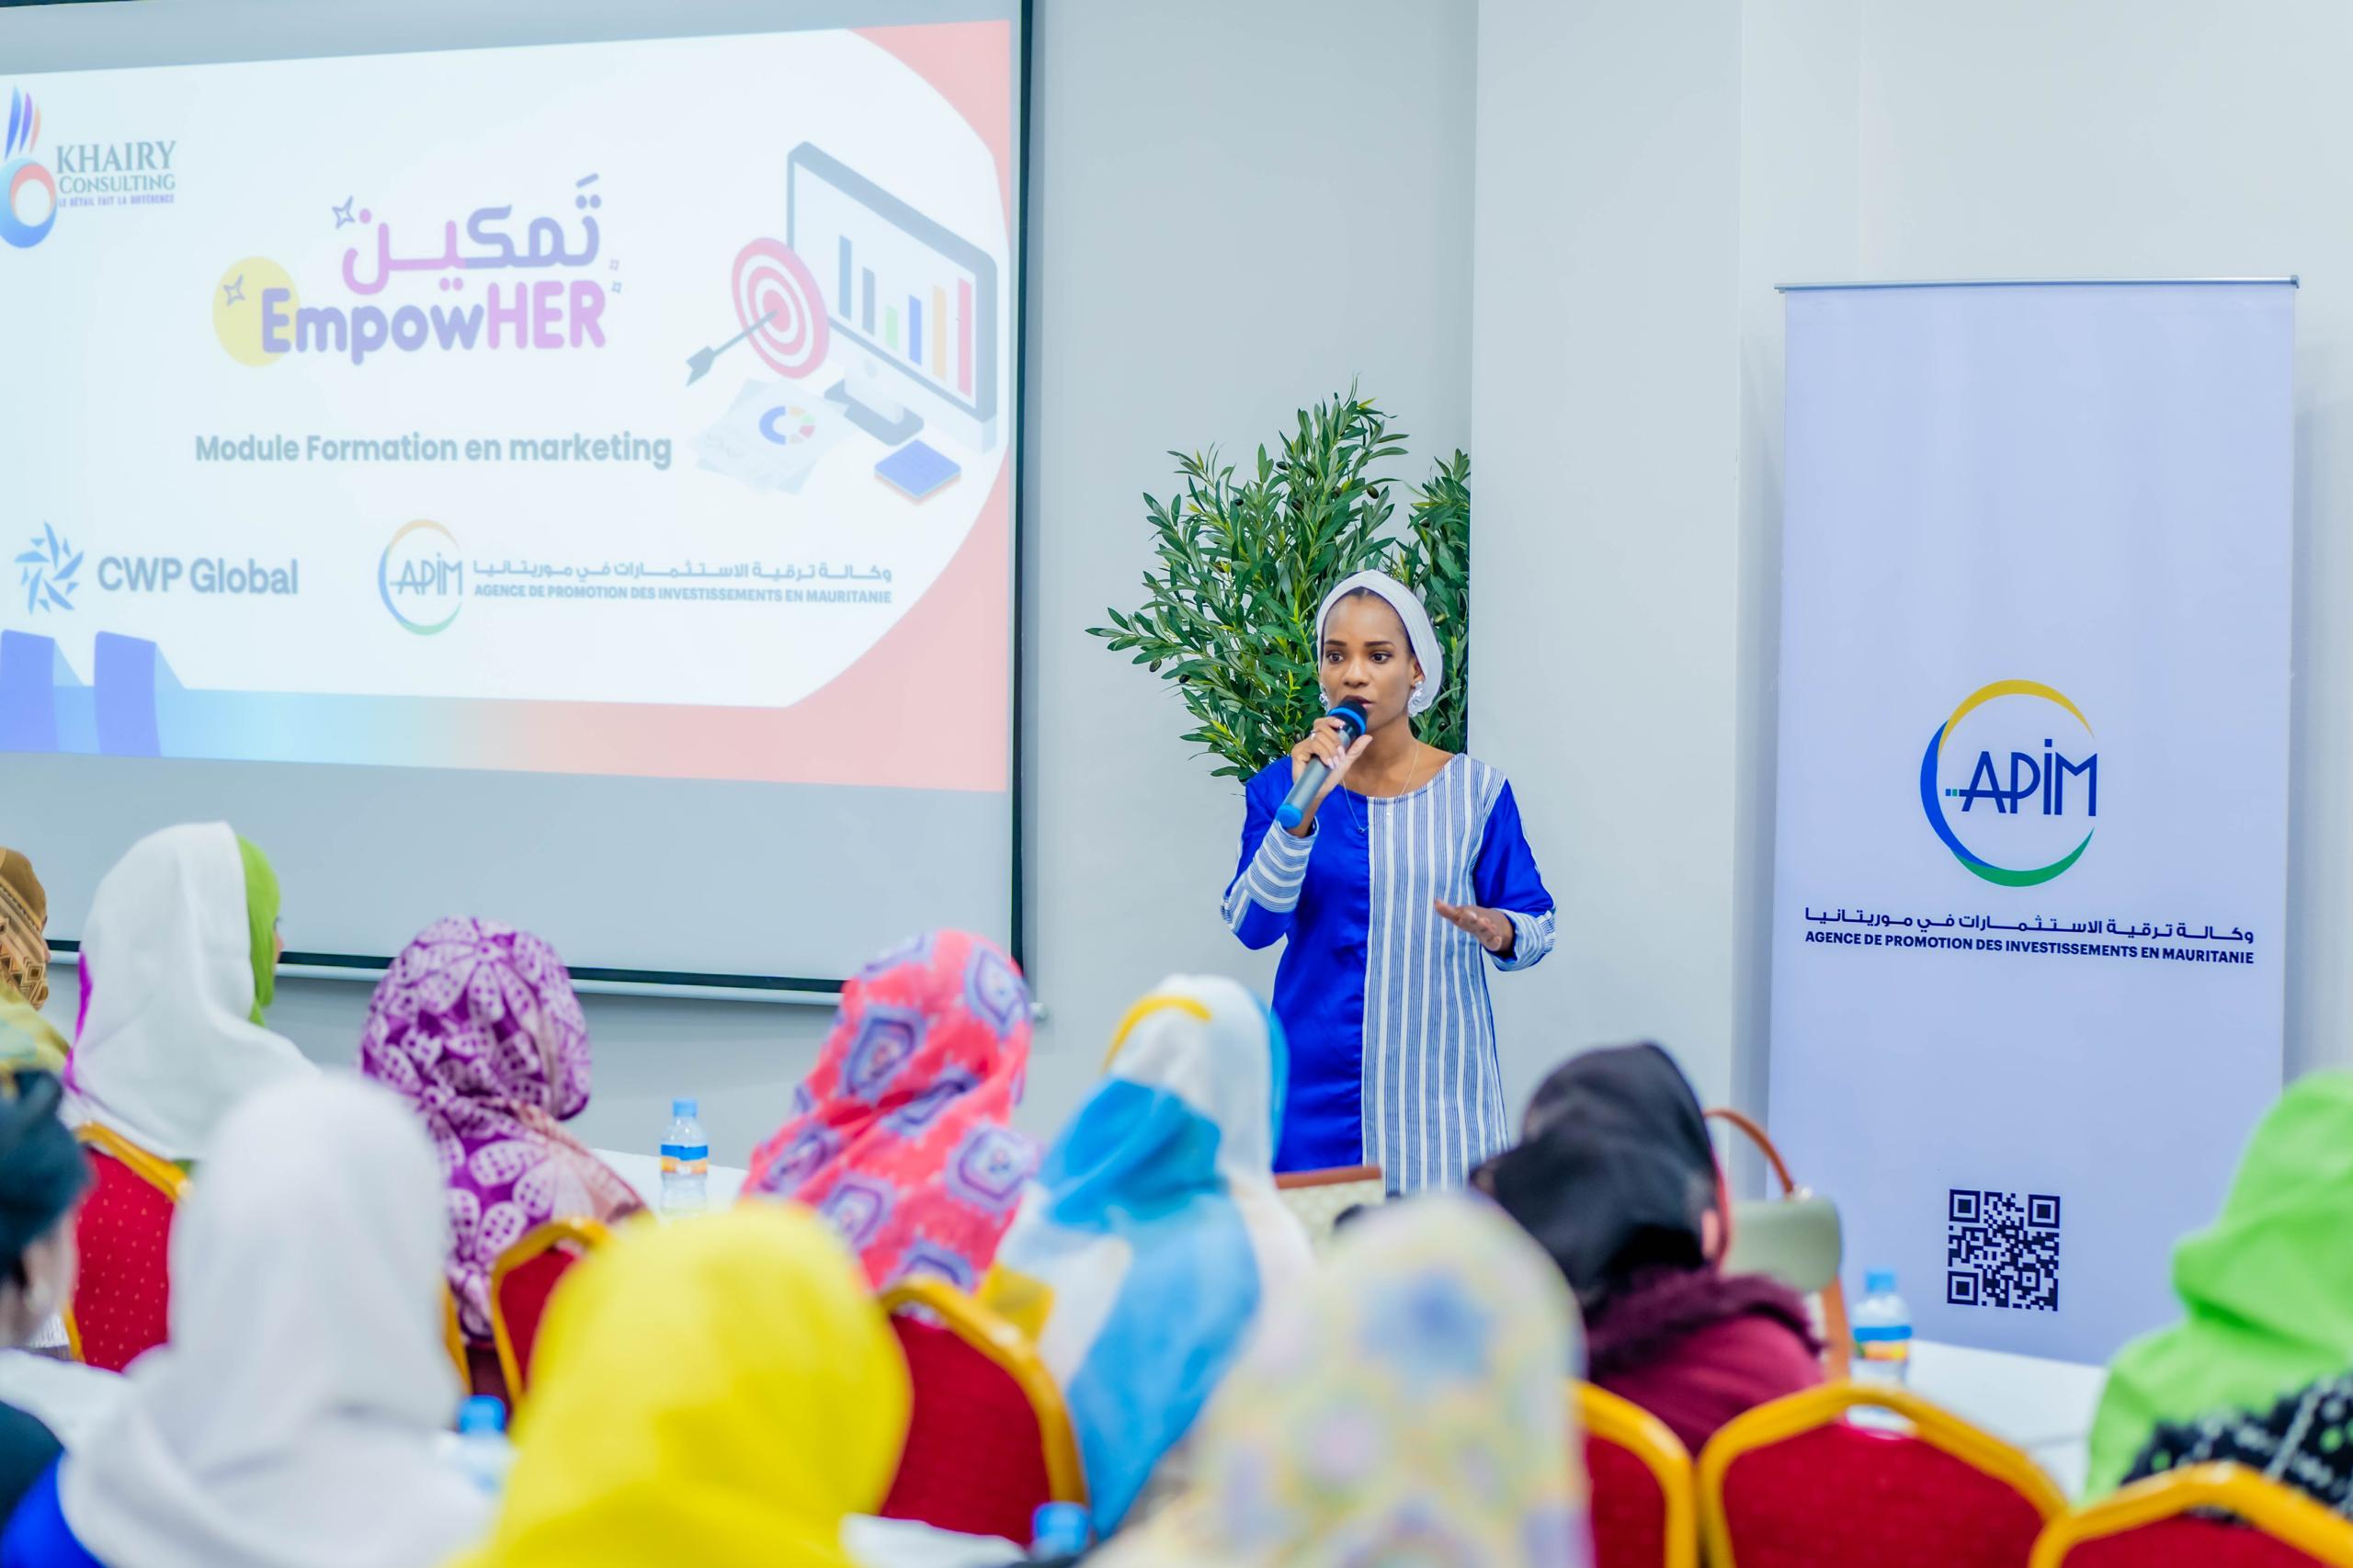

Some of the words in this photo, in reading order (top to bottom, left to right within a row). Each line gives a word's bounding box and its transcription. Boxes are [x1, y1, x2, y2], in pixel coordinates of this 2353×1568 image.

[56, 140, 176, 174] KHAIRY
[262, 279, 606, 367] EmpowHER
[195, 435, 300, 461] Module
[306, 432, 459, 461] Formation
[464, 439, 502, 461] en
[509, 431, 672, 470] marketing
[97, 556, 183, 592] CWP
[189, 557, 299, 596] Global
[474, 585, 527, 597] AGENCE
[529, 585, 545, 597] DE
[547, 585, 628, 599] PROMOTION
[631, 586, 655, 599] DES
[658, 587, 782, 603] INVESTISSEMENTS
[785, 589, 803, 603] EN
[806, 589, 892, 604] MAURITANIE
[1804, 906, 1914, 927] موريتانيا
[1916, 914, 1955, 933] في
[2106, 918, 2174, 939] ترقية
[1804, 930, 1861, 945] AGENCE
[1863, 933, 1882, 946] DE
[1884, 934, 1973, 950] PROMOTION
[1975, 937, 2004, 951] DES
[2005, 939, 2138, 958] INVESTISSEMENTS
[2140, 946, 2160, 960] EN
[2162, 947, 2255, 964] MAURITANIE
[2176, 922, 2255, 945] وكالة
